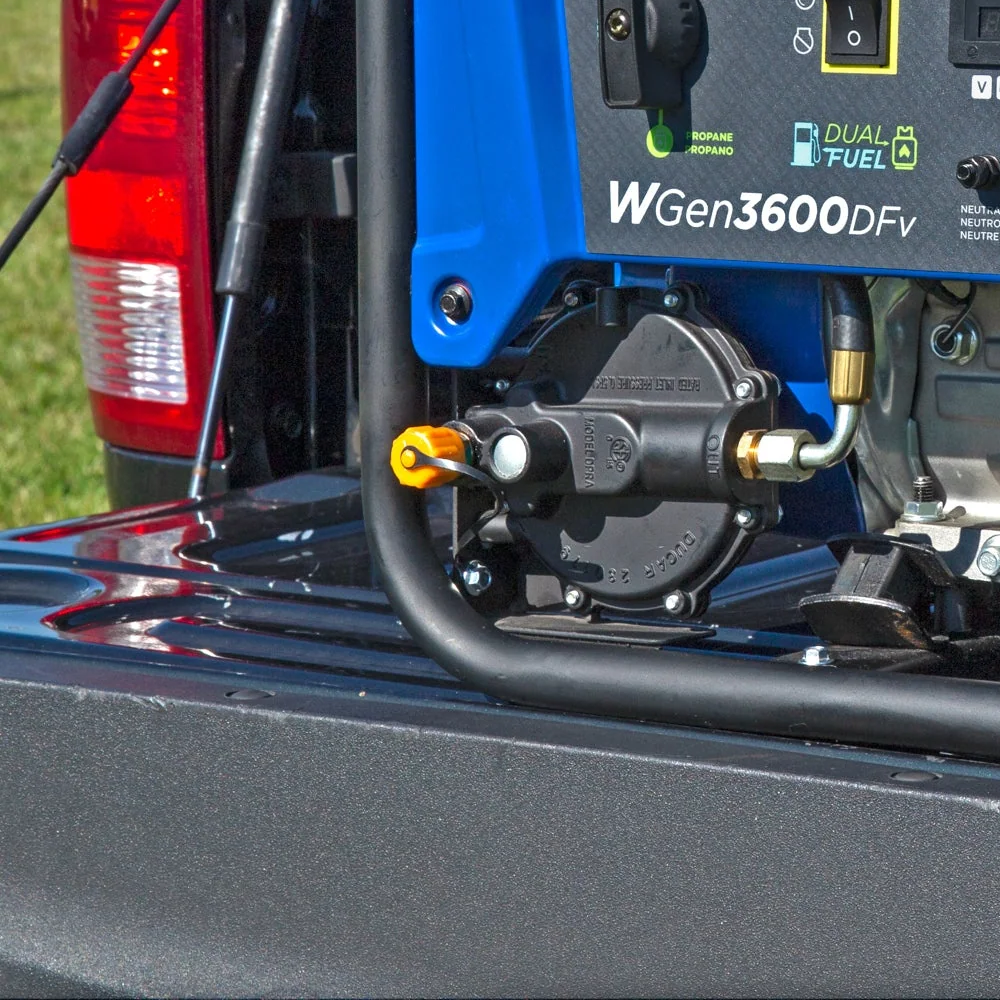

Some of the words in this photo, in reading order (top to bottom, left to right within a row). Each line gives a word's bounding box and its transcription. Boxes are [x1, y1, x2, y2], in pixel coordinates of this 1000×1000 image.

[977, 81, 987, 93] V
[685, 131, 734, 142] PROPANE
[824, 123, 886, 145] DUAL
[685, 145, 734, 156] PROPANO
[823, 147, 886, 170] FUEL
[609, 180, 917, 237] WGen3600DFv
[960, 218, 1000, 228] NEUTRO
[960, 231, 999, 241] NEUTRE
